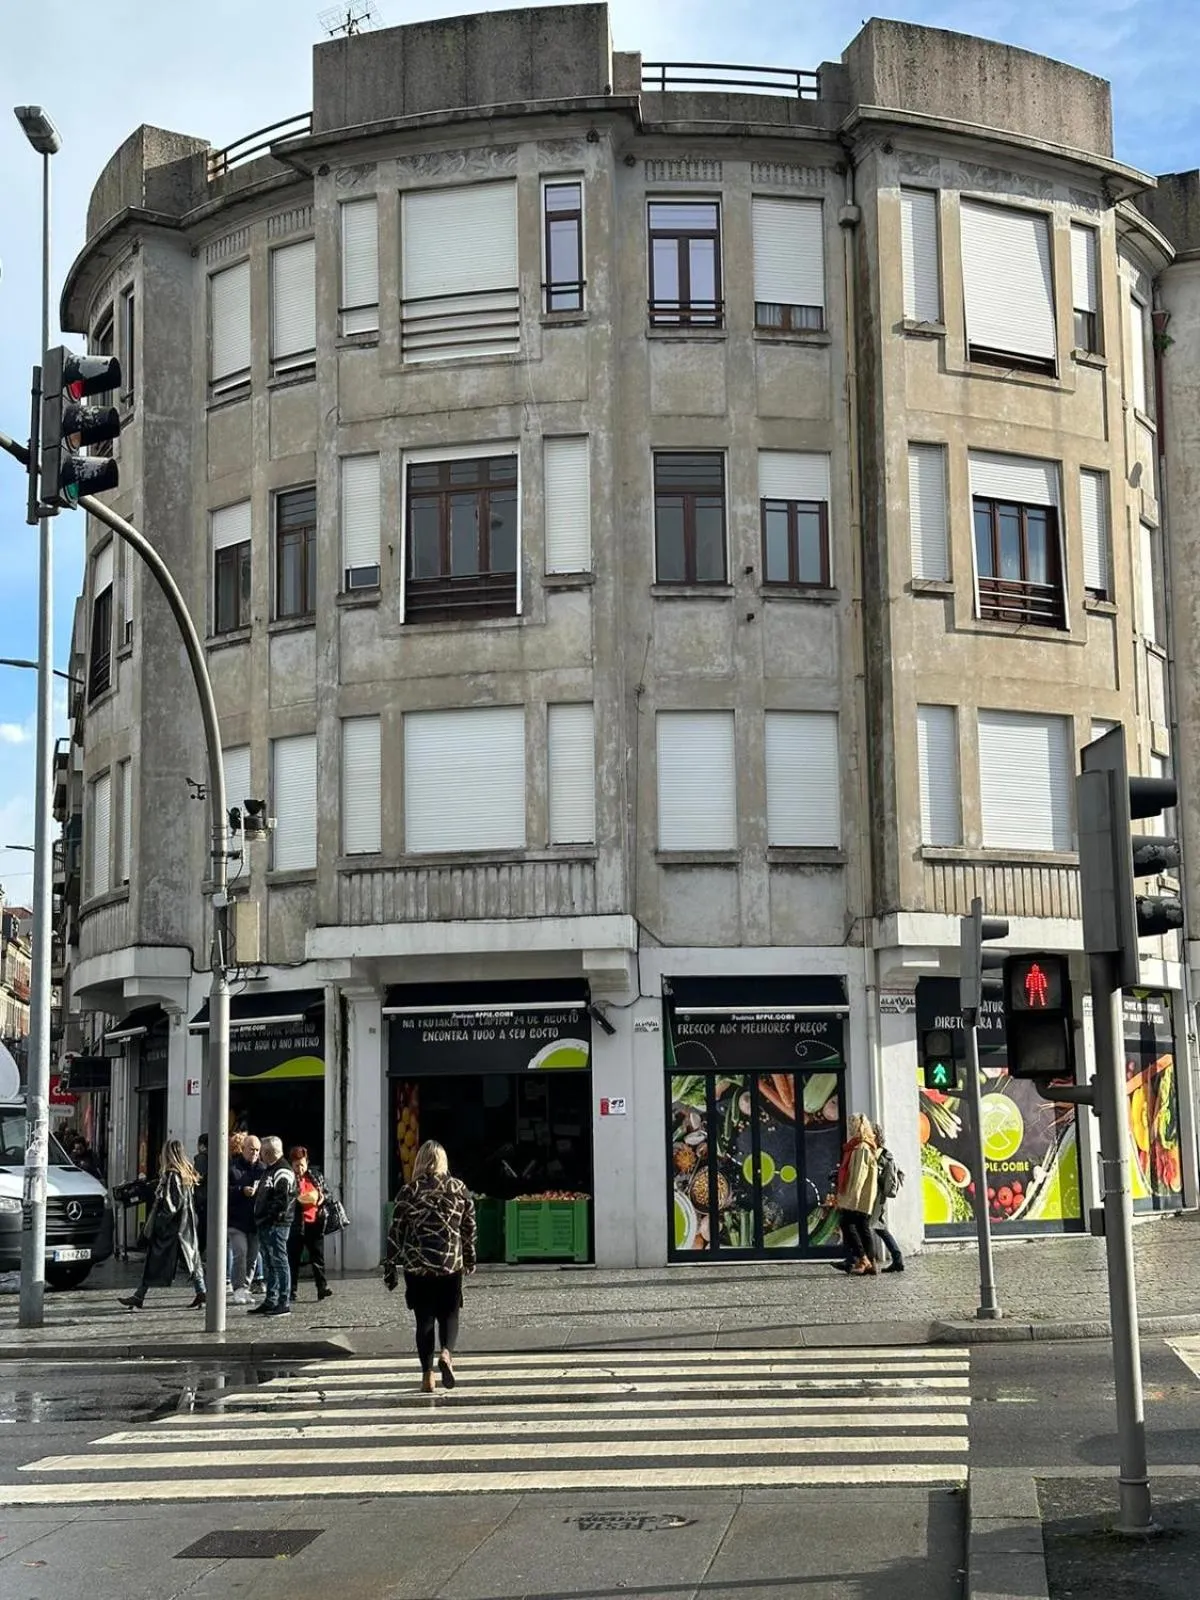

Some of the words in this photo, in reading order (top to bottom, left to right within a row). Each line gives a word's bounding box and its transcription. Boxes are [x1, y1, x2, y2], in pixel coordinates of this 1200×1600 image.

[422, 1029, 469, 1042] ENCONTRA
[472, 1028, 496, 1041] TUDO
[499, 1028, 506, 1040] A
[508, 1027, 526, 1040] SEU
[529, 1026, 559, 1040] GOSTO
[677, 1023, 716, 1035] FRESCOS
[719, 1023, 738, 1035] AOS
[741, 1022, 791, 1035] MELHORES
[793, 1022, 828, 1036] PREÇOS
